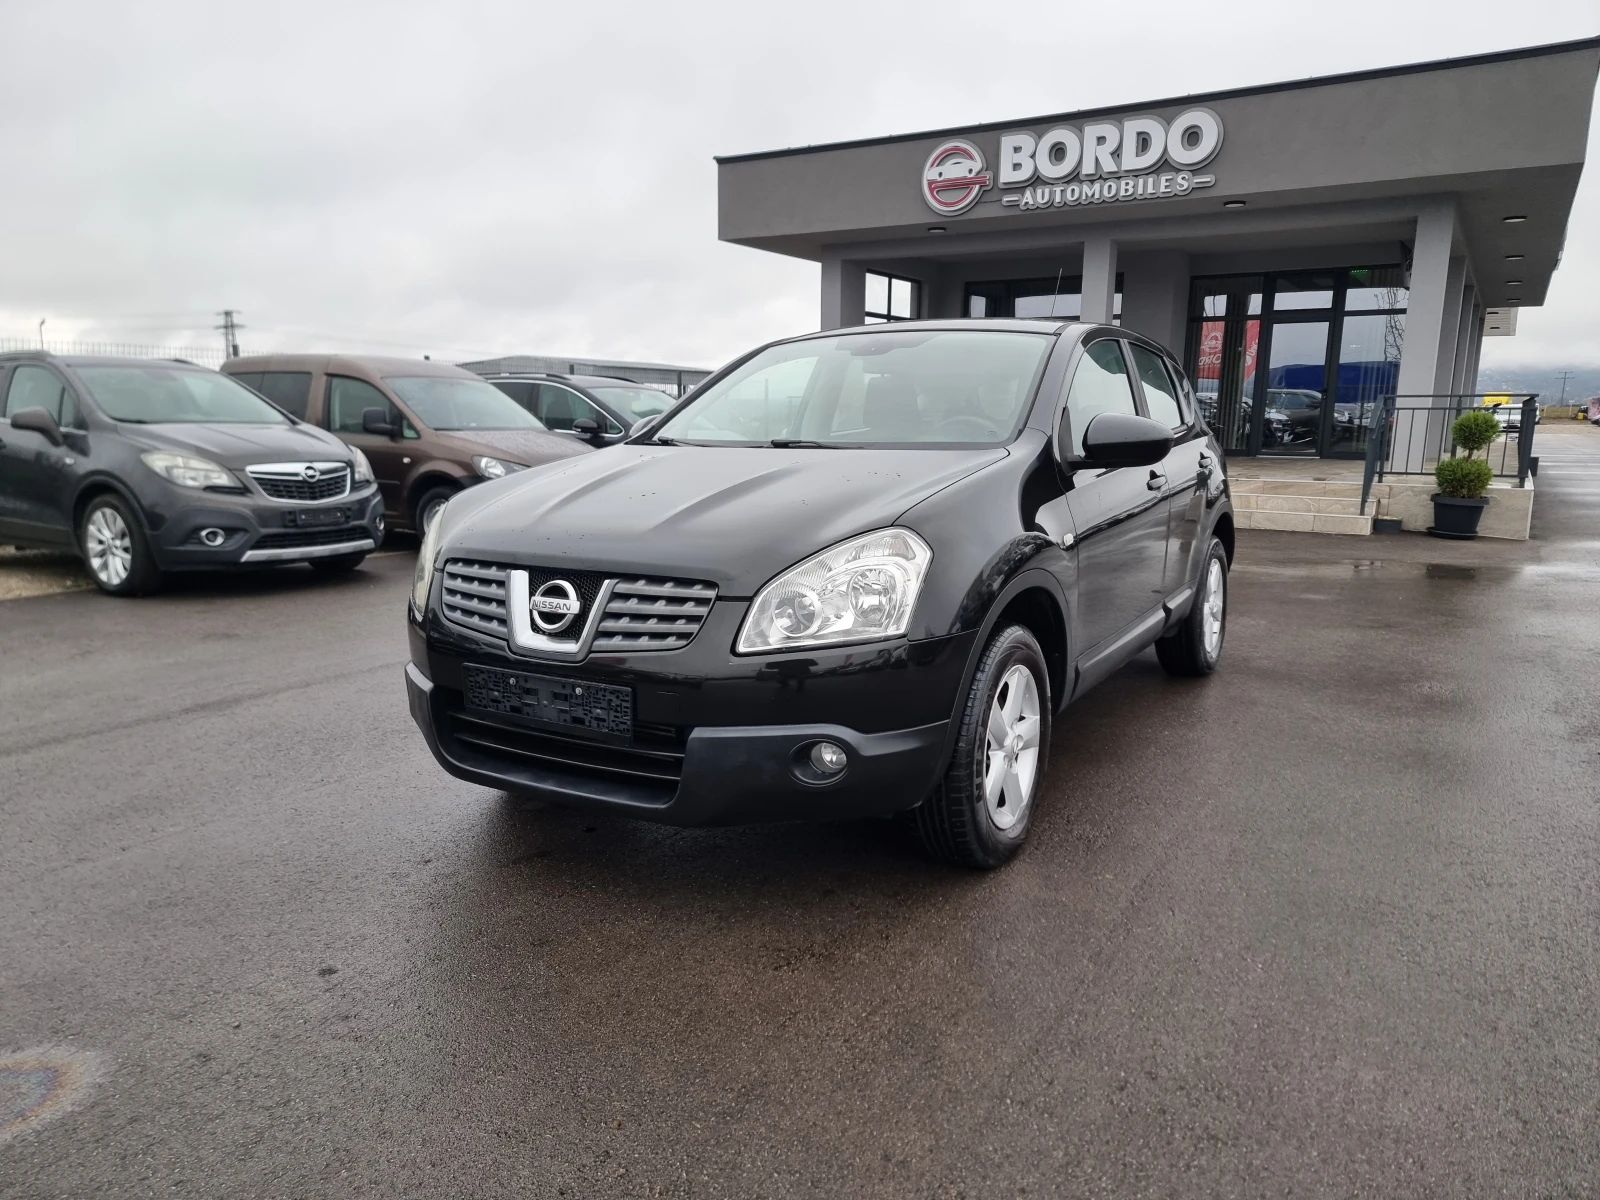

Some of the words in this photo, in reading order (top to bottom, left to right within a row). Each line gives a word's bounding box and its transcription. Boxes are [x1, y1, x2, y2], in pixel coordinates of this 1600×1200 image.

[1000, 111, 1220, 184] BORDO
[1020, 174, 1190, 206] AUTOMOBILES
[531, 599, 572, 612] NISSAN
